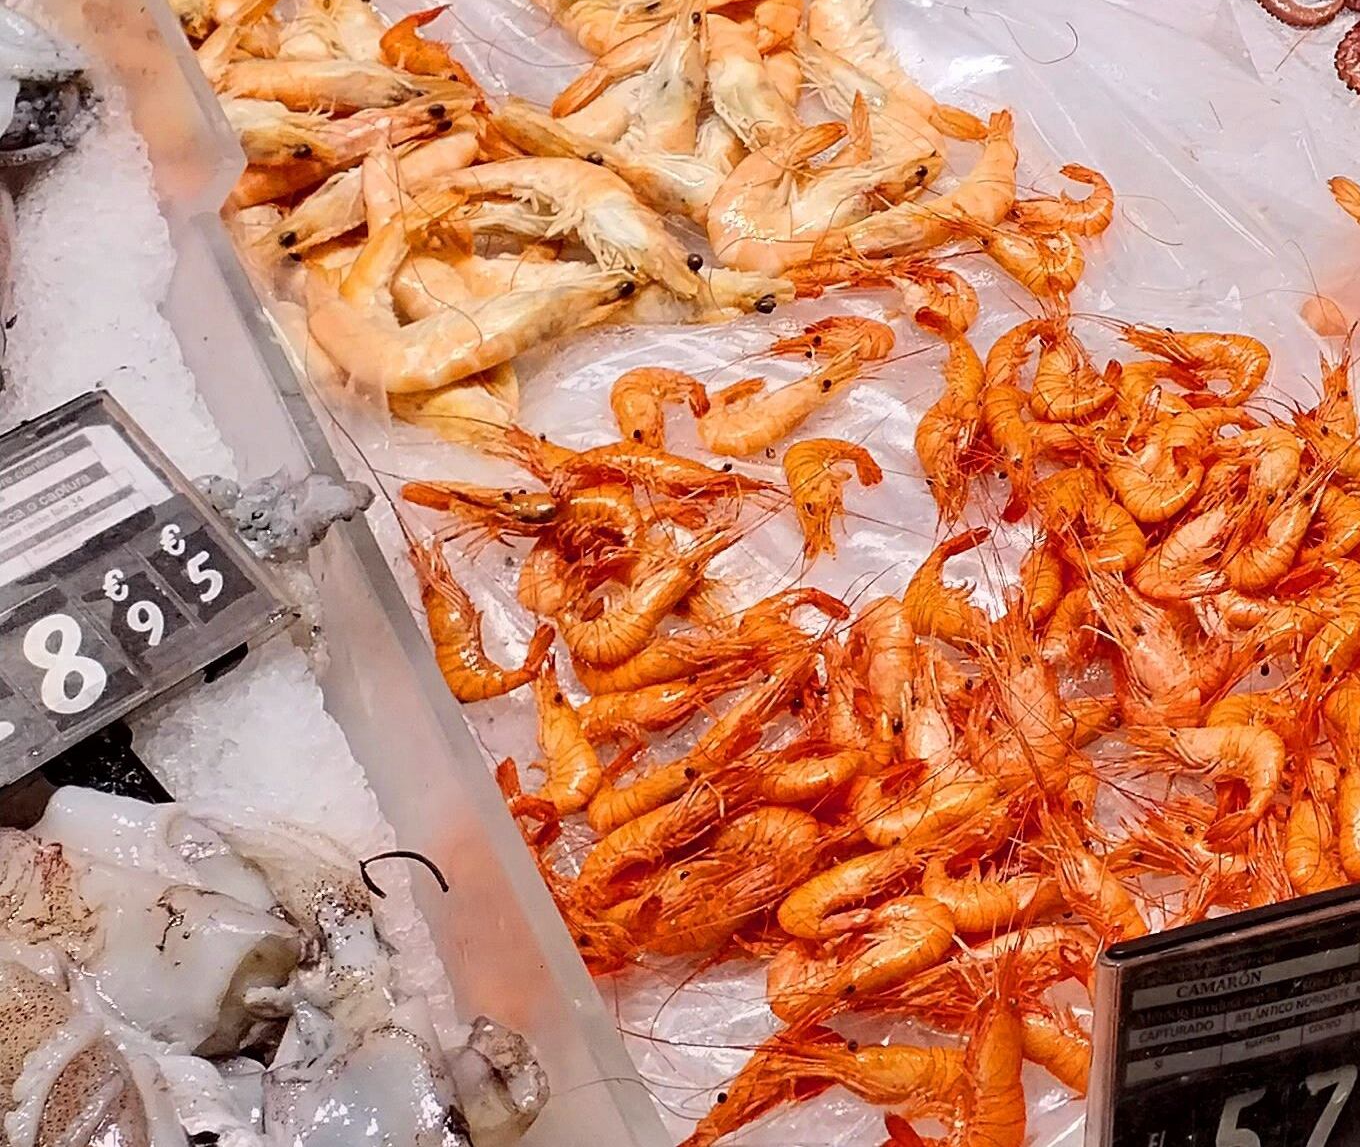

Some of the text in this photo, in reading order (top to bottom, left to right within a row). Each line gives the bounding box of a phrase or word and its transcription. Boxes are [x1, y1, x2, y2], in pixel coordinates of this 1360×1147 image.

[38, 474, 91, 505] captura
[23, 613, 106, 715] 8
[126, 550, 224, 647] 95
[1176, 970, 1262, 998] CAMARÓN
[1138, 1020, 1214, 1043] CAPTURADO
